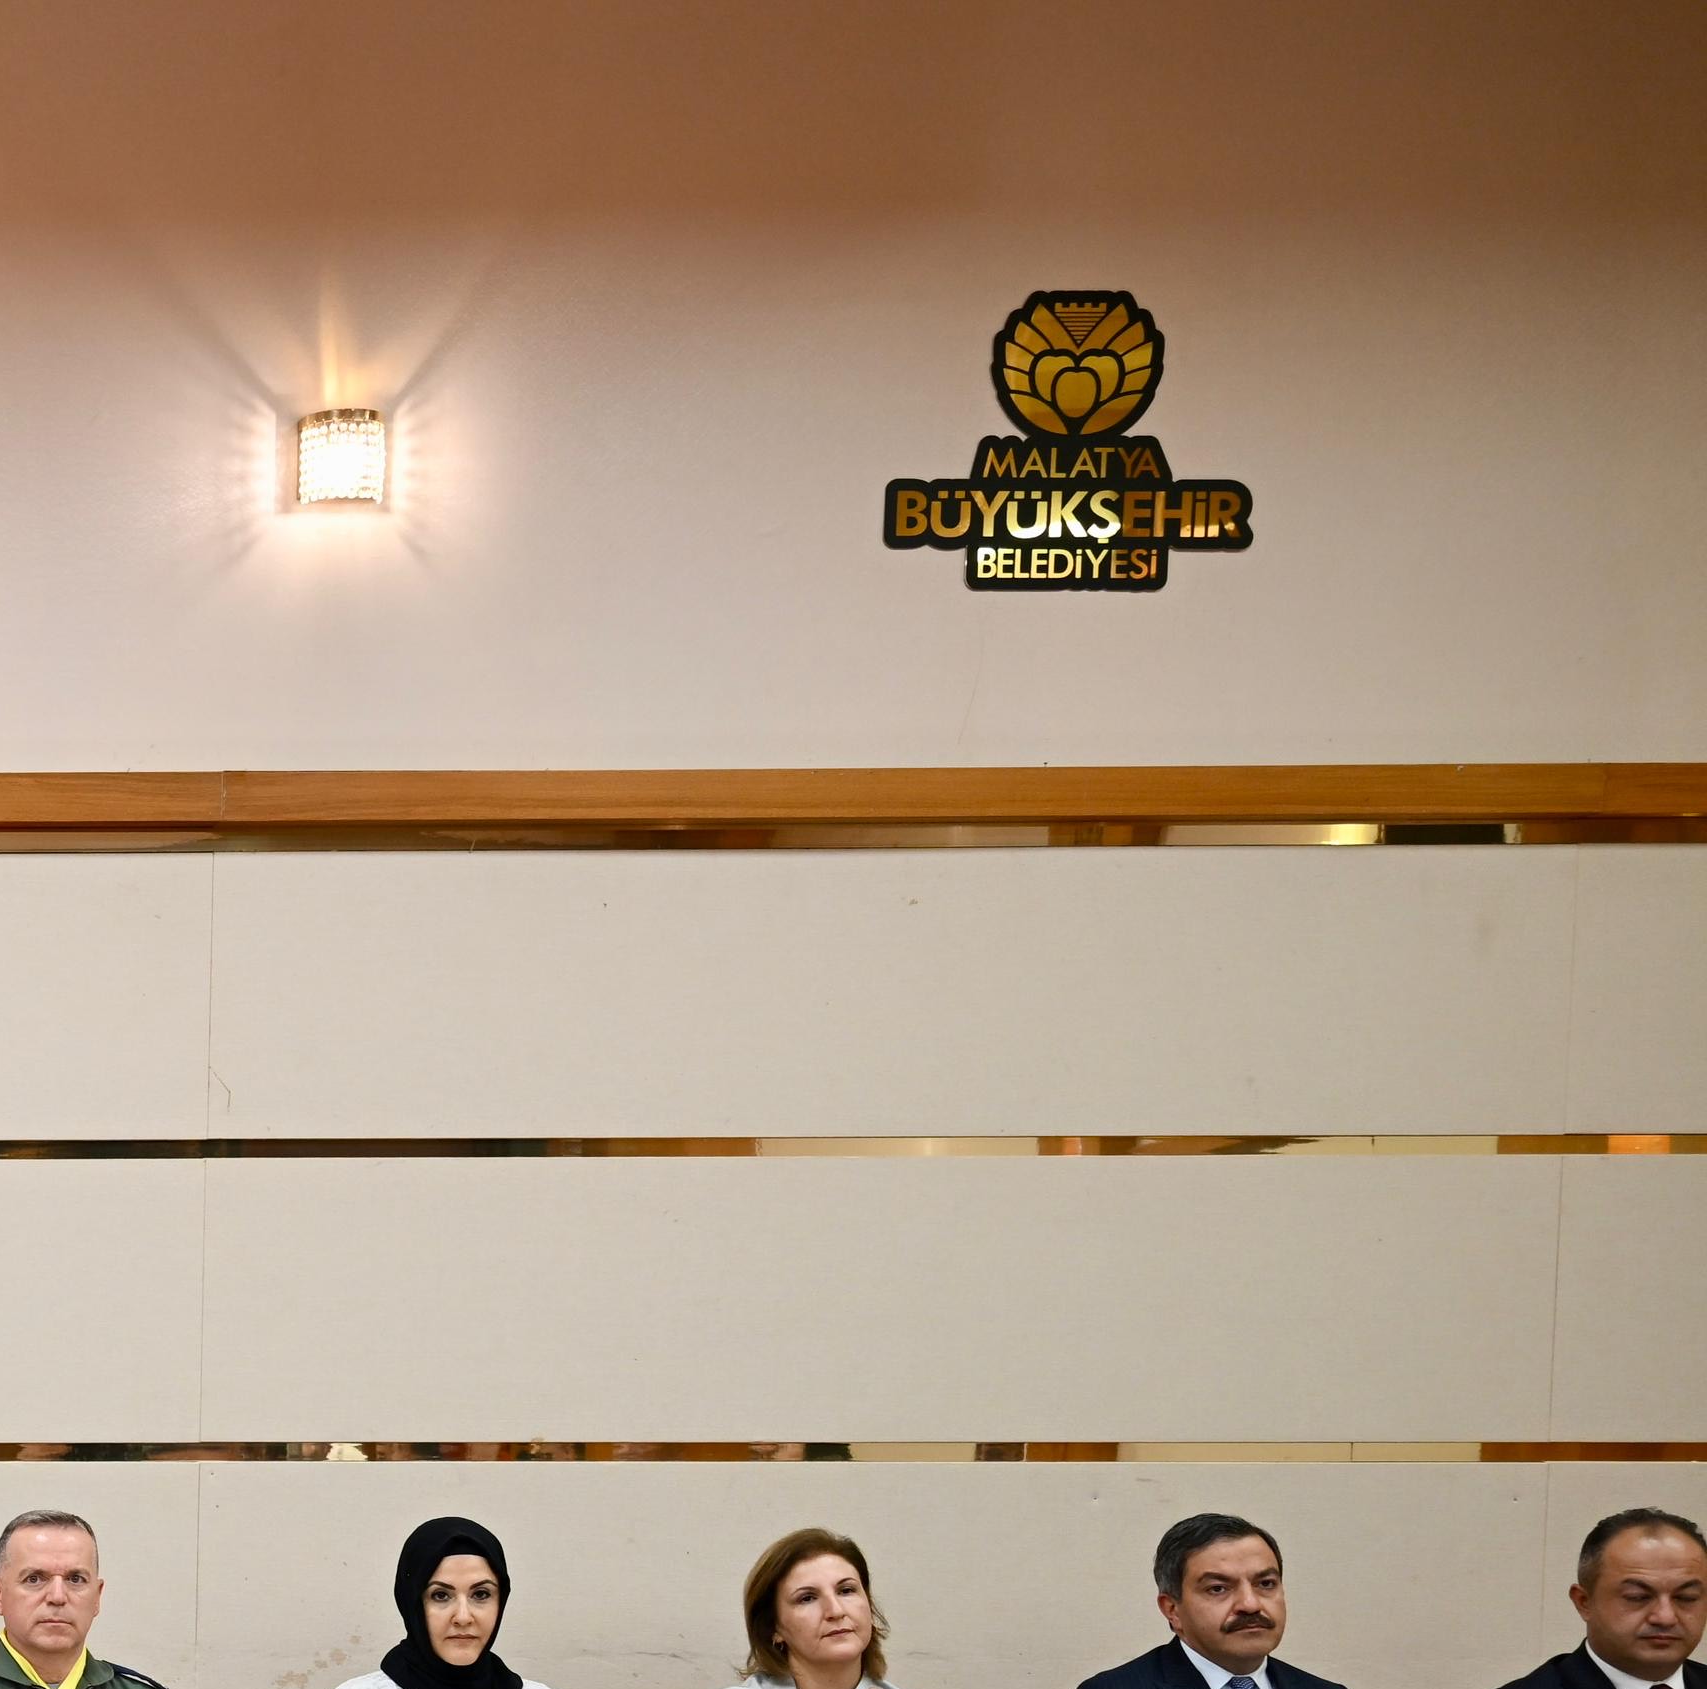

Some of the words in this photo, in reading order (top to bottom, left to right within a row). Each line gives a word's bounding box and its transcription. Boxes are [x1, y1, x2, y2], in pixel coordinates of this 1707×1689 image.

[982, 447, 1161, 479] MALATYA
[894, 489, 1242, 544] BÜYÜKŞEHİR
[976, 547, 1158, 579] BELEDİYESİ
